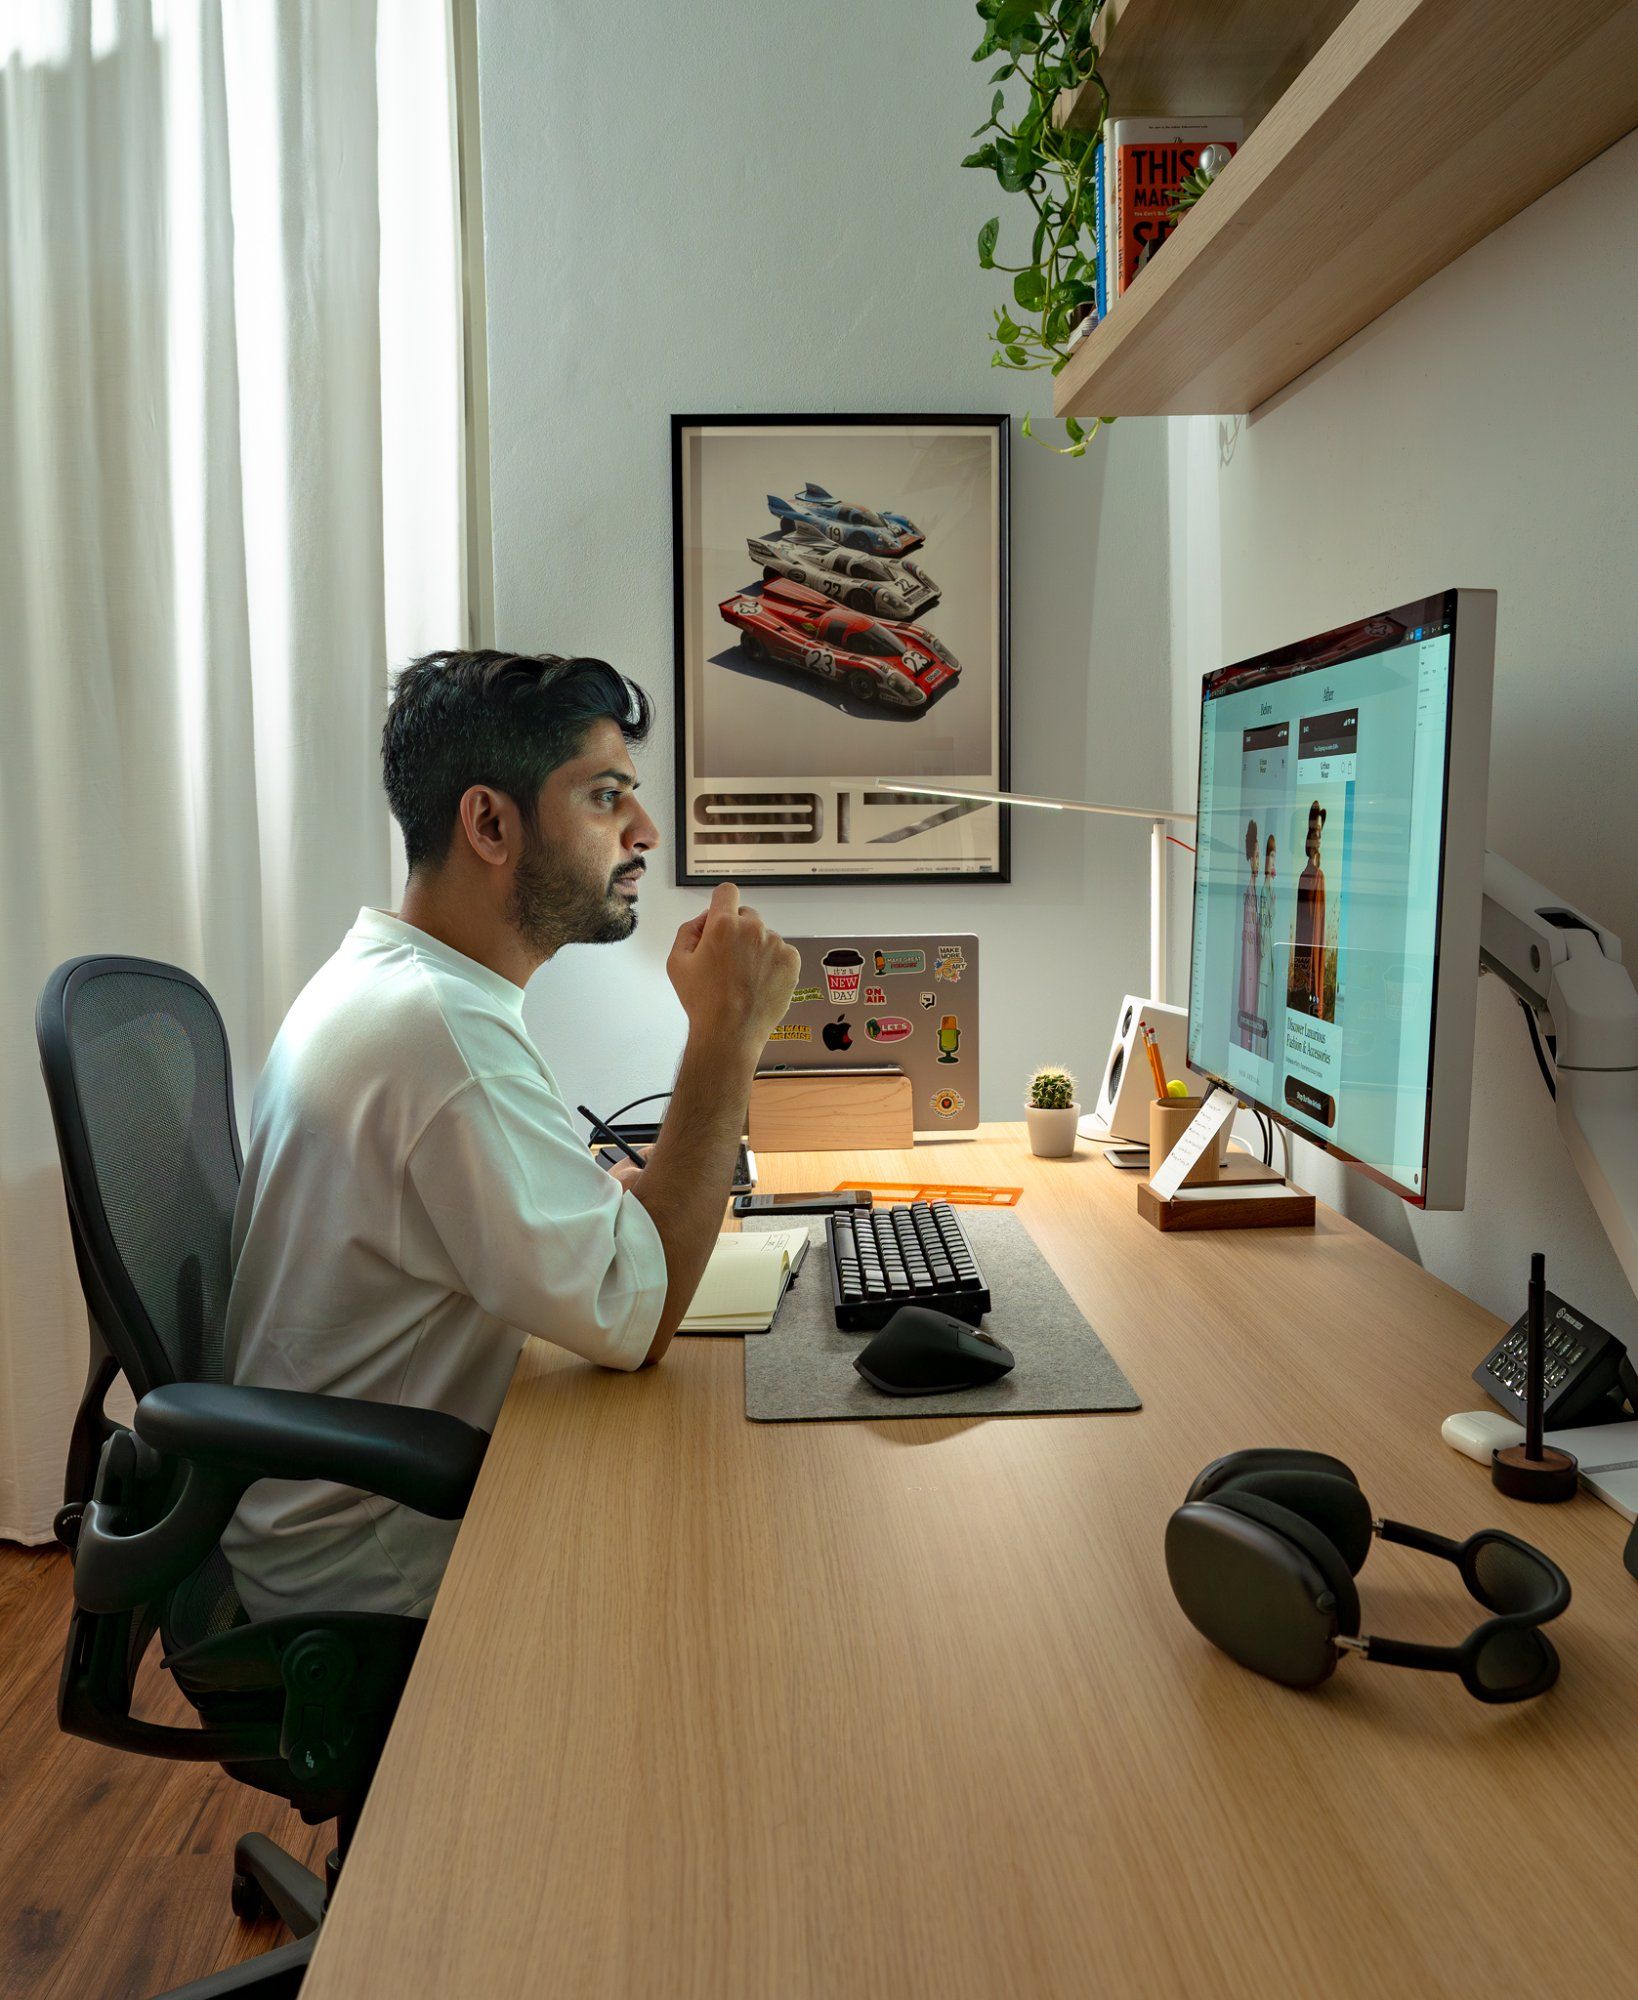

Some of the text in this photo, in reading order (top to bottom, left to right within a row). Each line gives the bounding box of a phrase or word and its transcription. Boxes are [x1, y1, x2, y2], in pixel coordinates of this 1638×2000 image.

[1131, 149, 1196, 185] THIS
[828, 525, 841, 542] 19
[894, 578, 917, 593] 22
[809, 650, 833, 673] 23
[902, 651, 930, 673] 23
[693, 793, 992, 845] 917
[940, 952, 961, 960] MORE
[830, 976, 858, 989] NEW
[832, 991, 855, 1001] DAY
[865, 988, 882, 996] ON
[866, 995, 886, 1004] AIR
[881, 1023, 908, 1031] LET'S
[1287, 1016, 1304, 1036] Discover
[1304, 1022, 1327, 1044] Luxurious
[785, 1032, 811, 1041] NOISE
[1286, 1033, 1302, 1052] Fashion
[1307, 1042, 1331, 1065] Accessories
